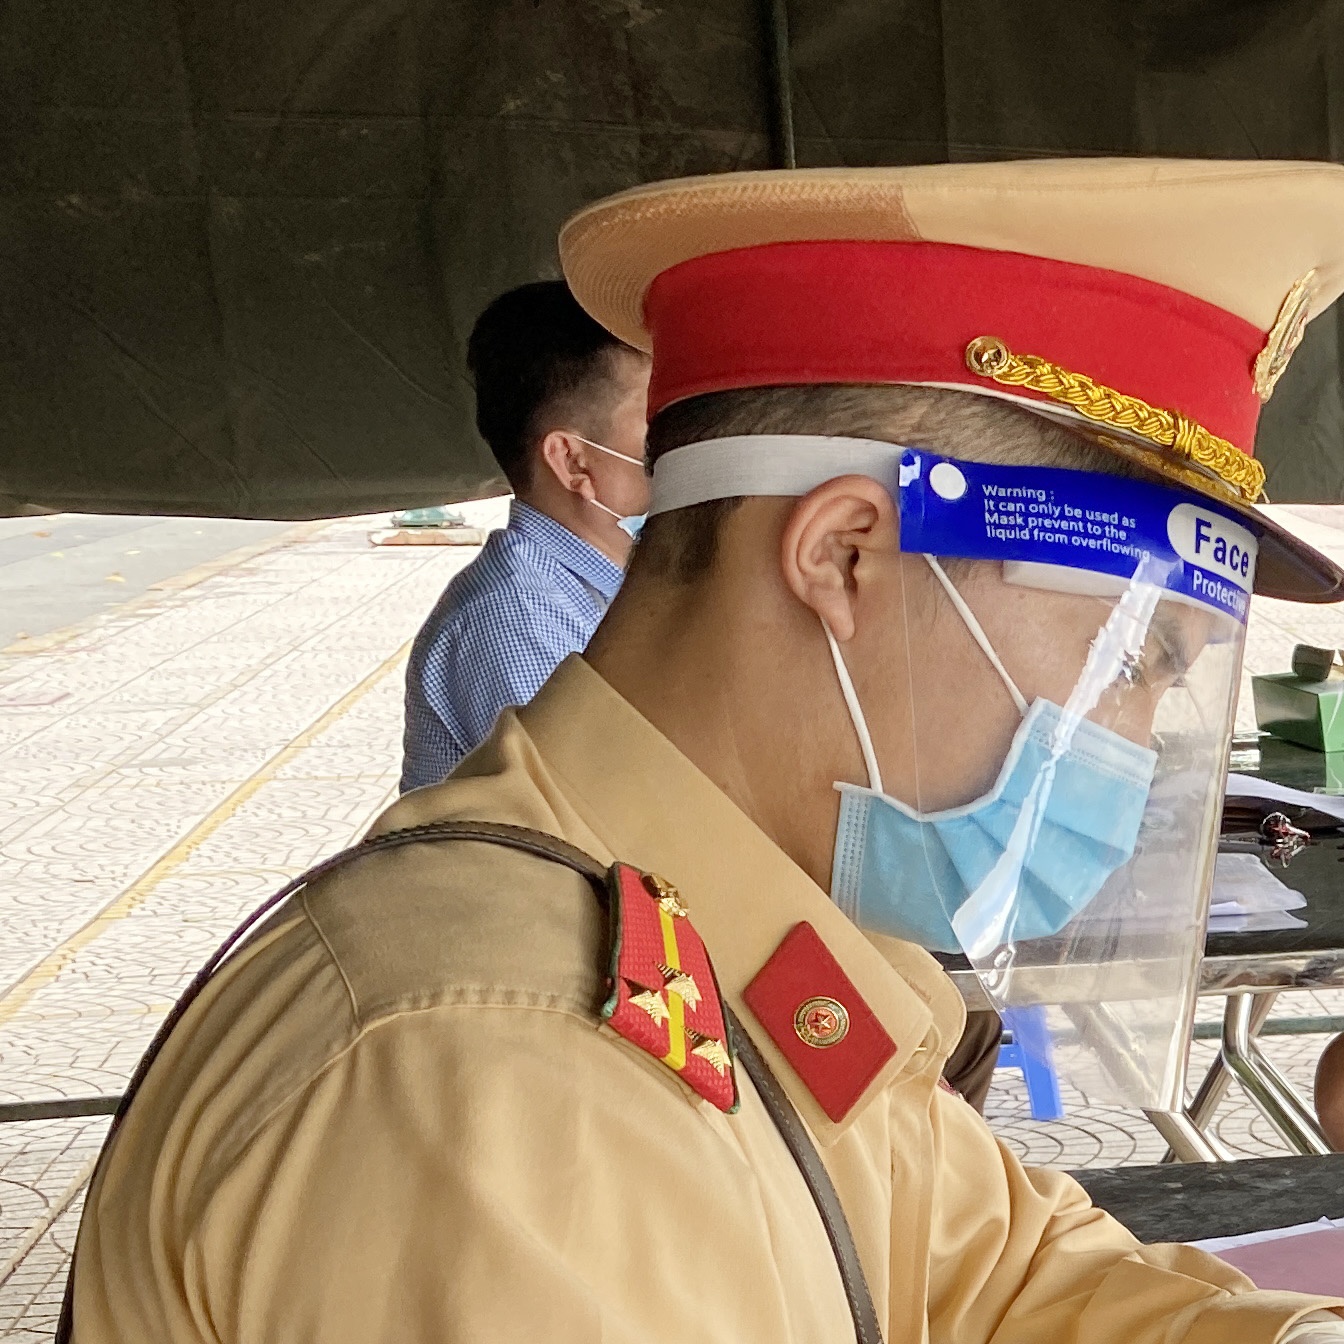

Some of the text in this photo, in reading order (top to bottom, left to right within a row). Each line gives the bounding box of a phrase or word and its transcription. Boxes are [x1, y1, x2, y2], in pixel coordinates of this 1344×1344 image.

[982, 484, 1046, 502] Warning
[985, 512, 1127, 540] Mask prevent to the
[999, 502, 1025, 512] can
[1029, 501, 1061, 518] only
[1064, 504, 1082, 518] be
[1086, 511, 1118, 524] used
[1122, 516, 1136, 528] as
[986, 526, 1151, 562] liquid from overflowing
[1195, 517, 1249, 578] Face
